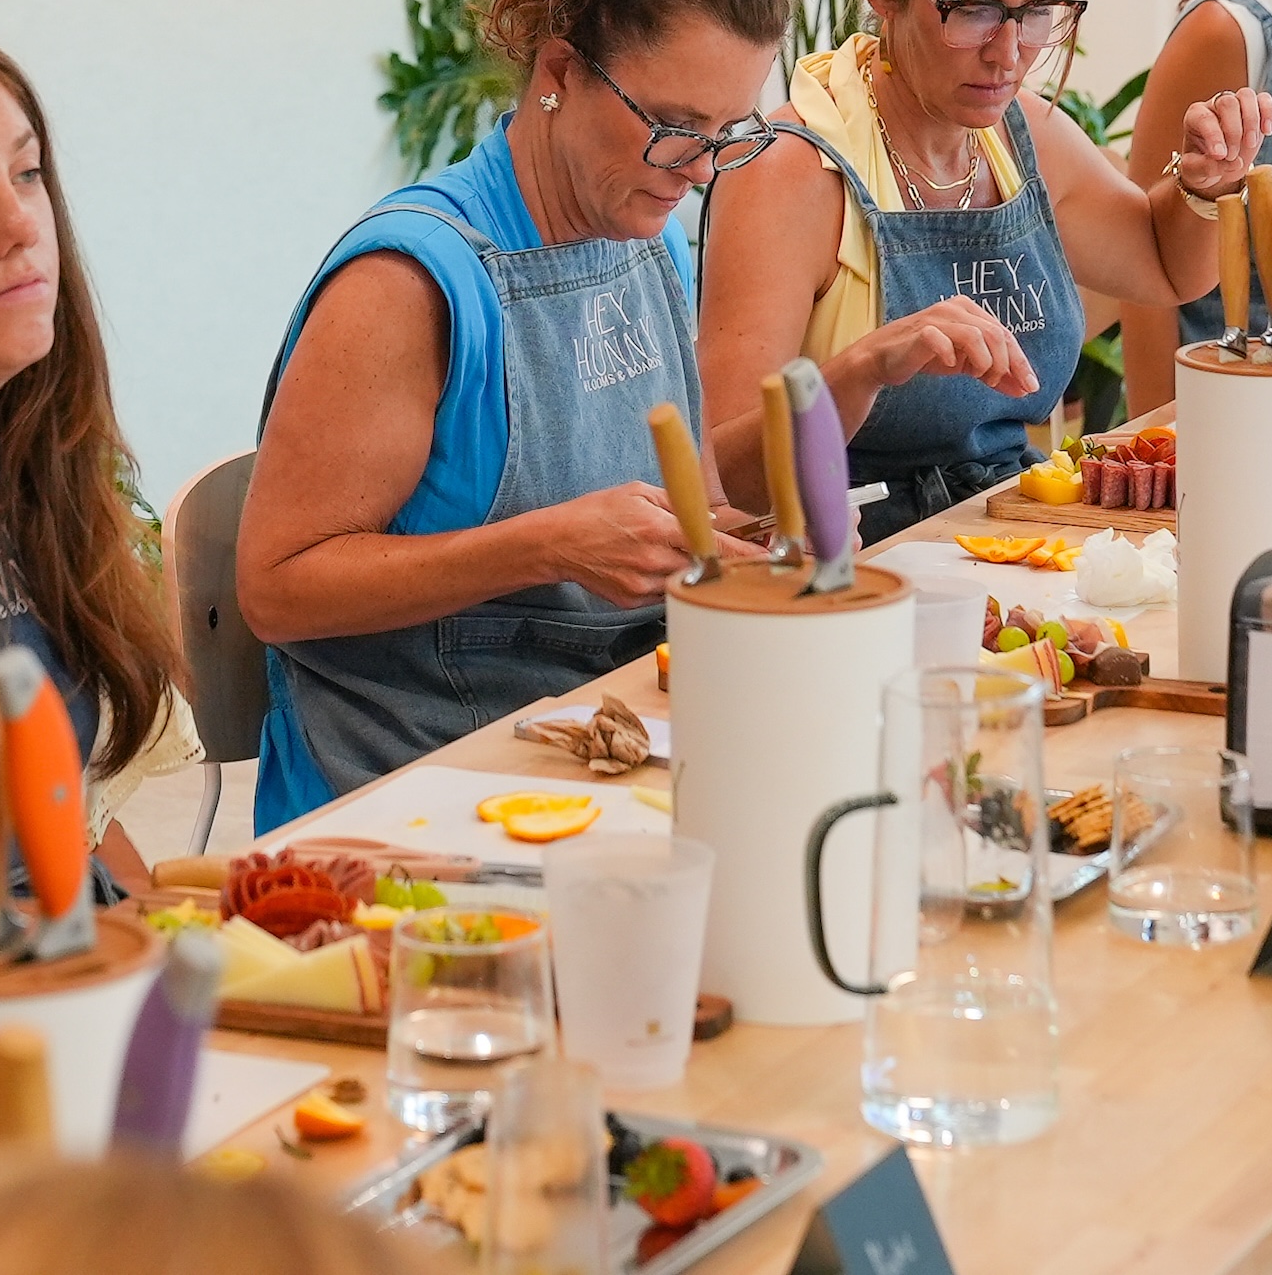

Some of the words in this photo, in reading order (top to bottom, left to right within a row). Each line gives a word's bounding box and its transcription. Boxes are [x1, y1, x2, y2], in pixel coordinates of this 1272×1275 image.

[952, 253, 1025, 295] HEY
[584, 287, 632, 338] HEY
[1005, 317, 1046, 334] OARDS
[573, 315, 662, 380] HUNNY
[617, 370, 626, 382] &
